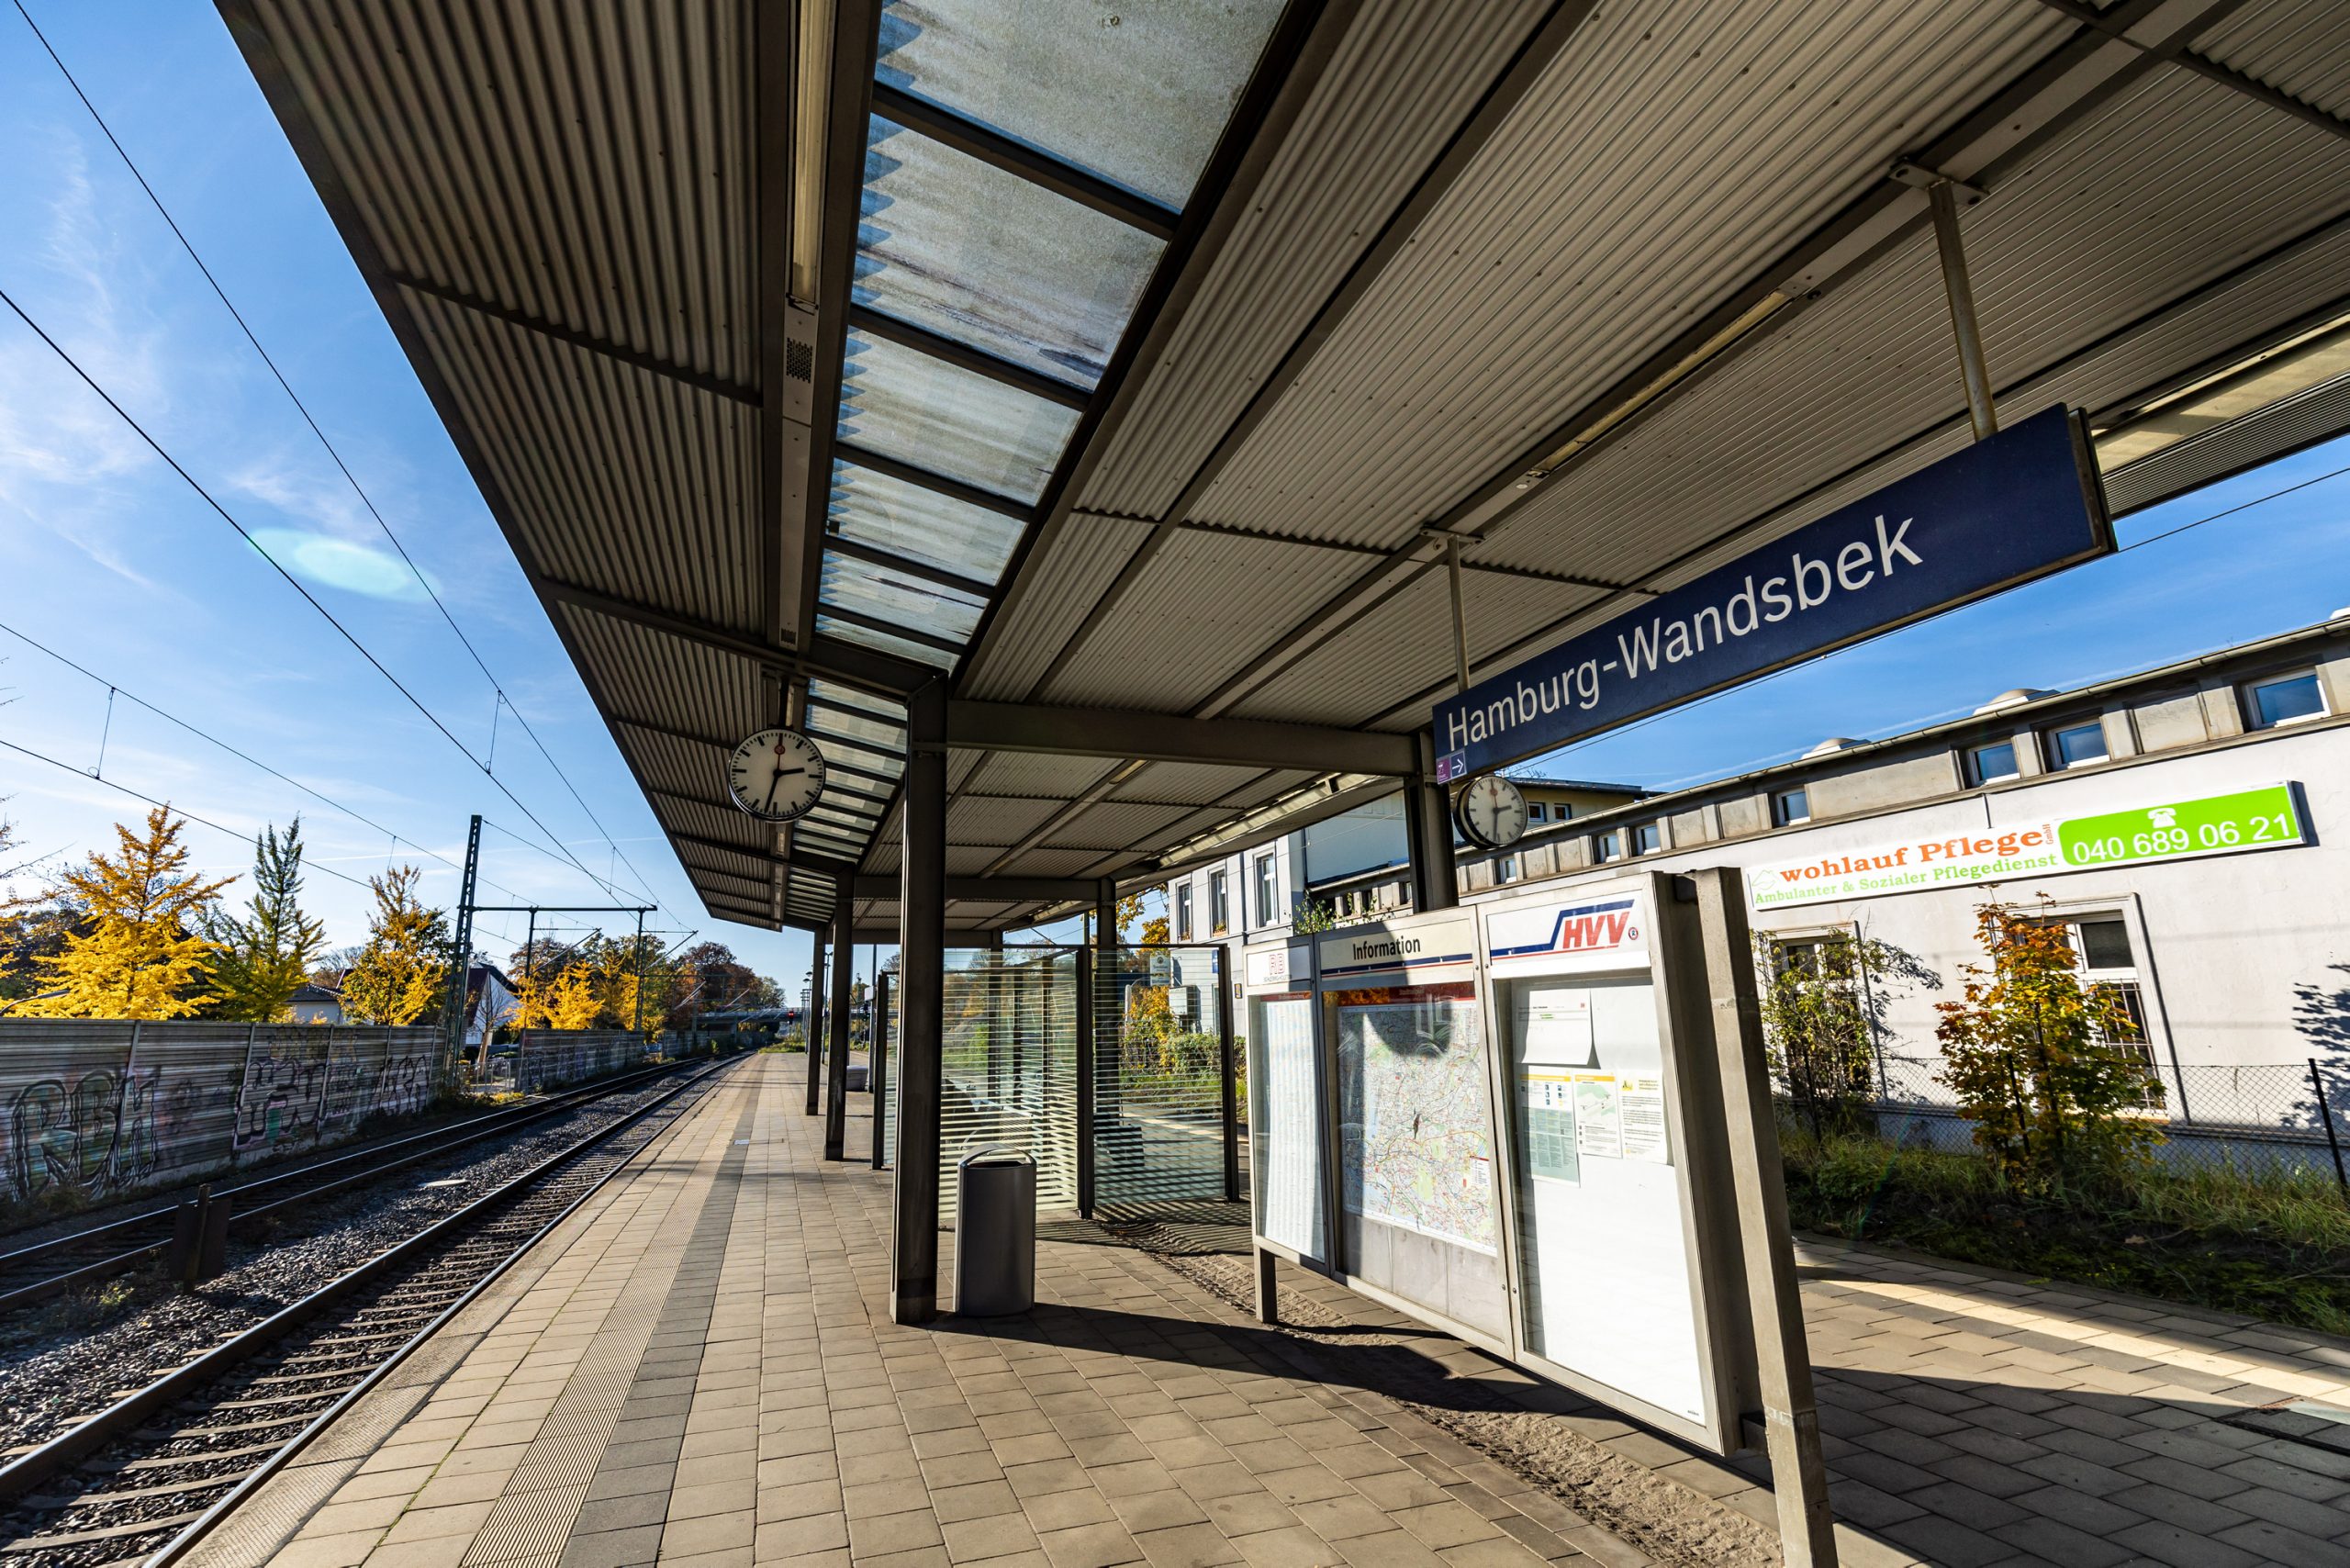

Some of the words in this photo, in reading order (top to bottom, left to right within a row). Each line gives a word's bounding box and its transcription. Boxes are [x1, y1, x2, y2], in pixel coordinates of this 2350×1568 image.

[1448, 514, 1923, 751] Hamburg-Wandsbek
[1781, 846, 1908, 882] wohlauf
[1918, 830, 2042, 863] Pflege
[2042, 823, 2053, 845] GmbH
[2073, 836, 2124, 864] 040
[2133, 827, 2189, 855] 689
[2199, 821, 2240, 847] 06
[2248, 812, 2290, 842] 21
[1755, 885, 1837, 904] Ambulanter
[1843, 881, 1855, 892] &
[1859, 871, 1927, 890] Sozialer
[1933, 853, 2058, 880] Pflegedienst
[1353, 935, 1421, 960] Information
[1562, 911, 1630, 949] HVV
[1269, 952, 1285, 975] RB
